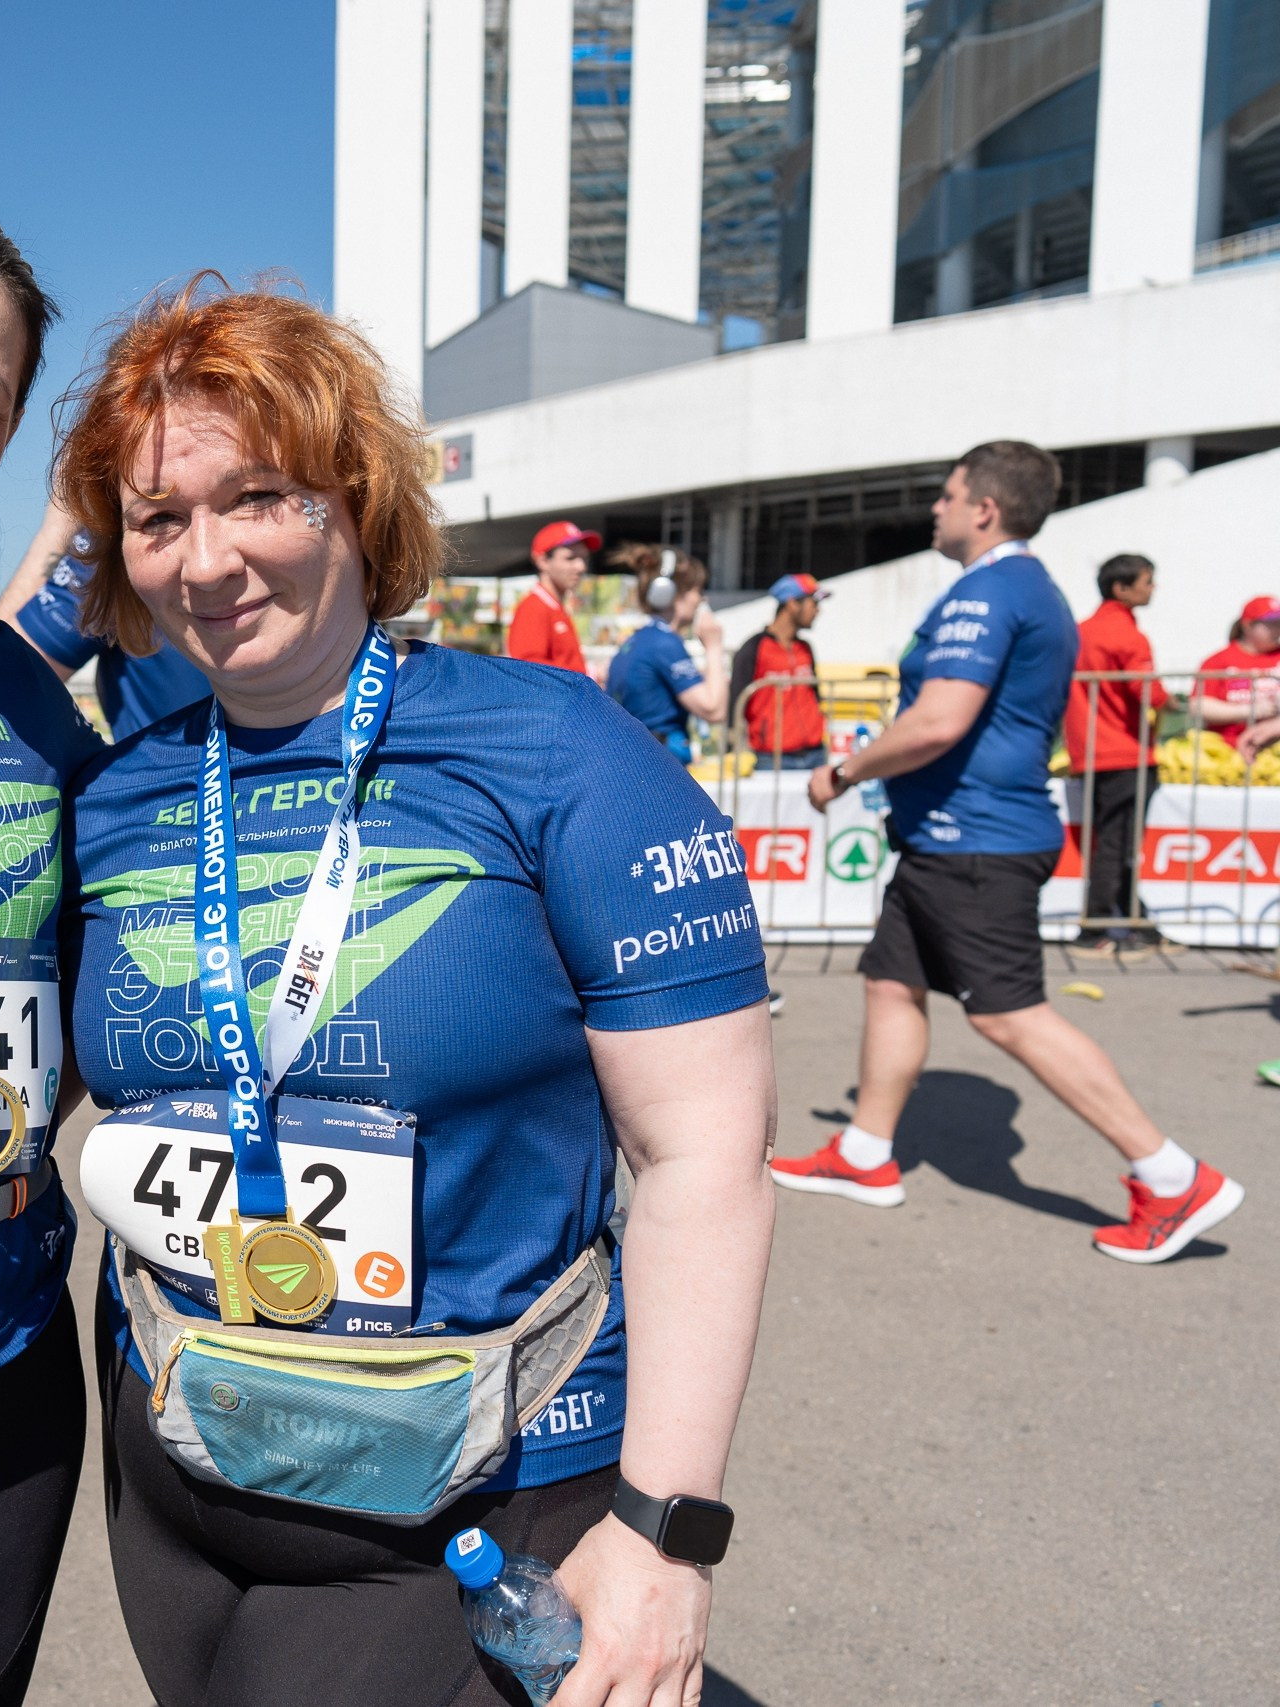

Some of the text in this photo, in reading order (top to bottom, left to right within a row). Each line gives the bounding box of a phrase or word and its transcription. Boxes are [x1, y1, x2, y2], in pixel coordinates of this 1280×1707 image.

[350, 658, 387, 732] ЭТОТ
[149, 843, 159, 853] 10
[203, 765, 227, 897] МЕНЯЮТ
[204, 902, 235, 993] ЭТОТ
[613, 903, 752, 974] рейтинг
[323, 1117, 396, 1133] НИЖНИЙ НОВГОРОД
[360, 1129, 396, 1140] 19.05.2024
[133, 1143, 347, 1242] 472
[364, 1321, 393, 1332] ПСБ
[264, 1450, 382, 1477] SIMPLIFY MY LIFE
